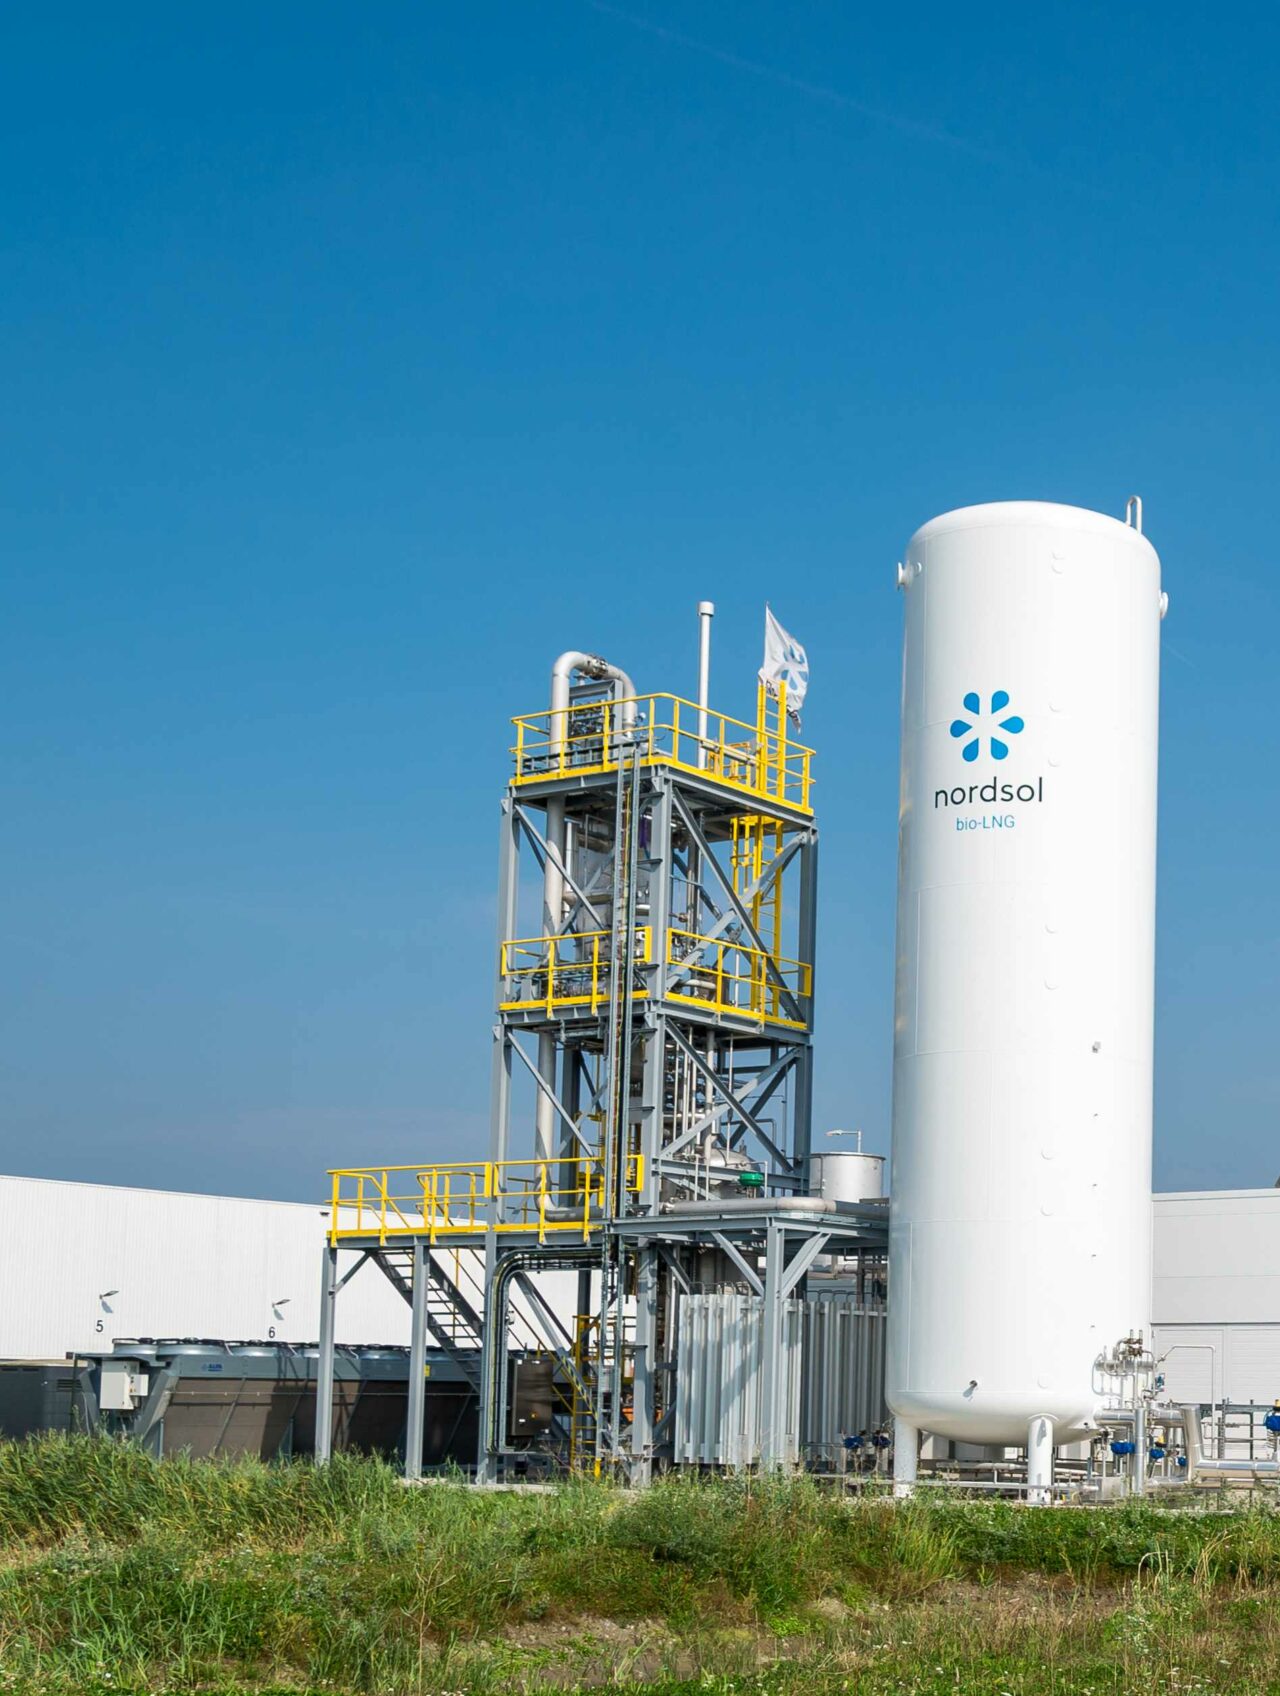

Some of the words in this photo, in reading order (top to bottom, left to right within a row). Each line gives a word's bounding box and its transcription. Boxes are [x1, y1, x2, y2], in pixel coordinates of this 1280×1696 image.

[934, 776, 1043, 809] nordsol
[956, 814, 1016, 831] bio-LNG
[96, 1319, 104, 1333] 5
[268, 1326, 276, 1339] 6
